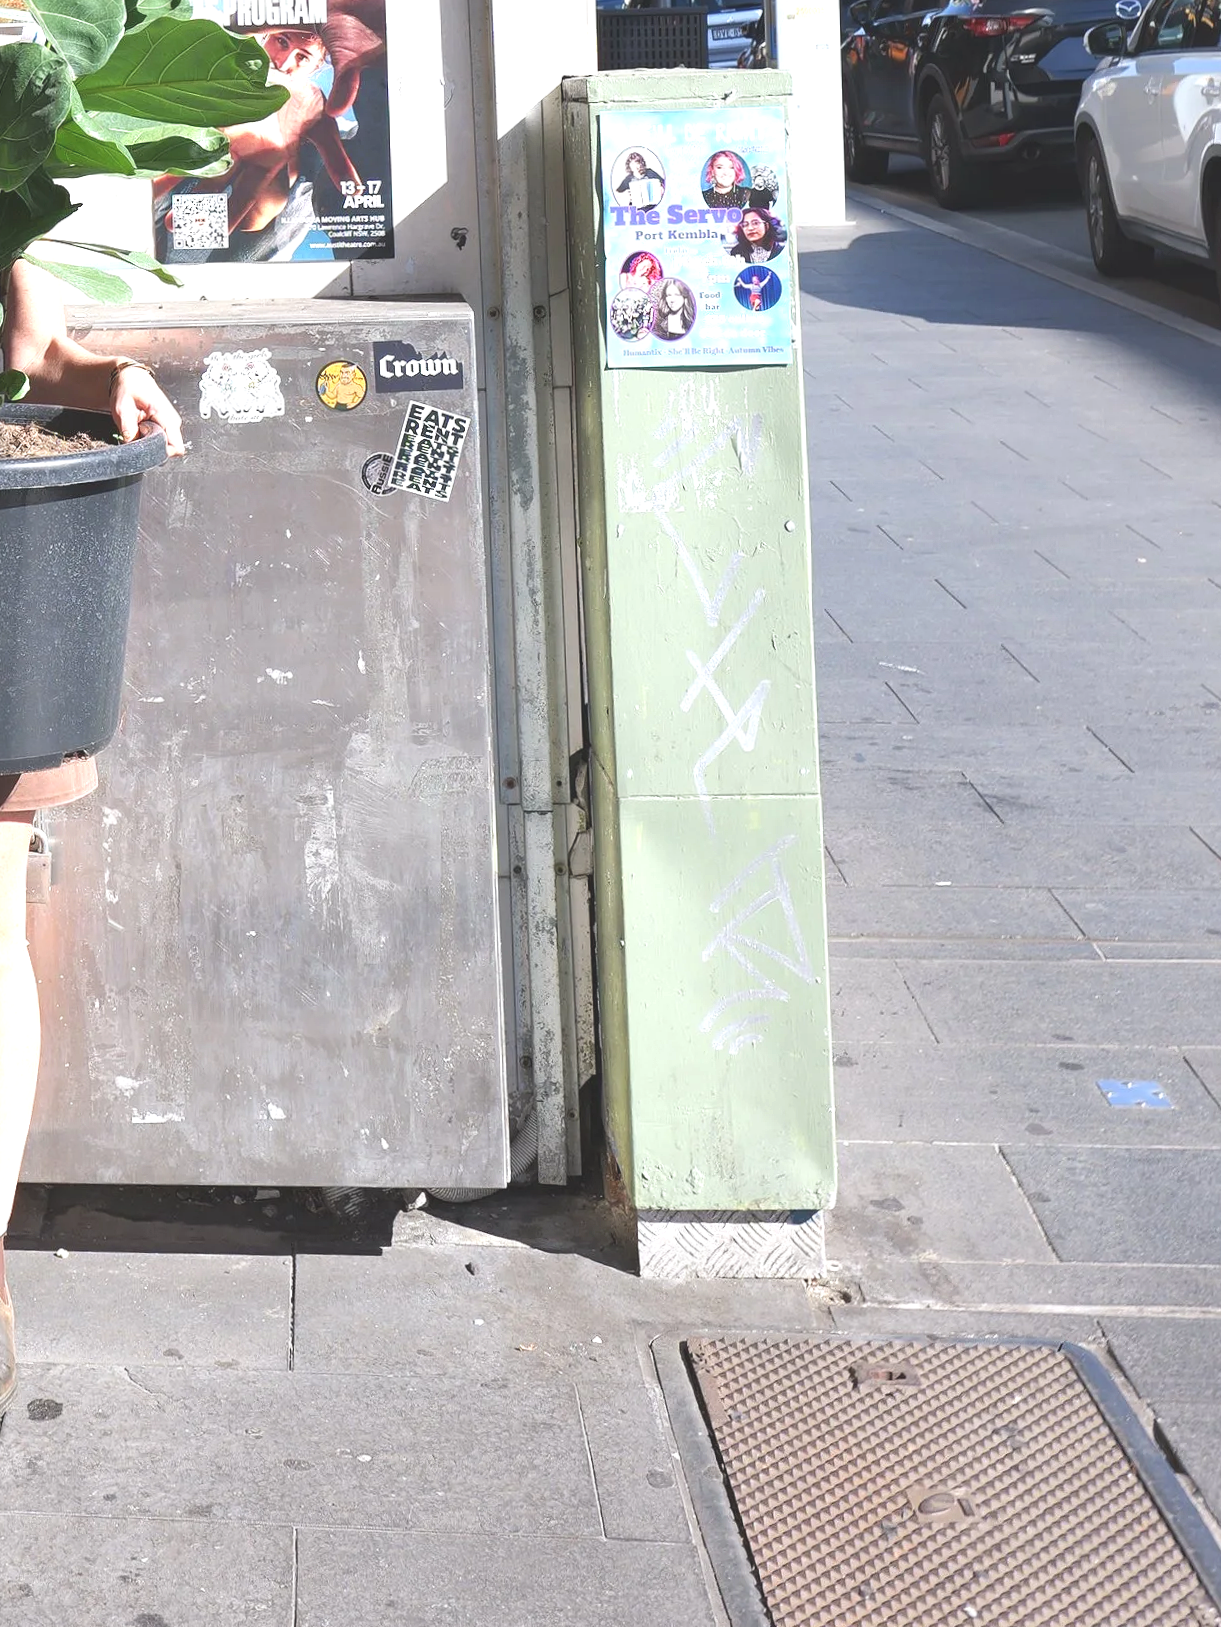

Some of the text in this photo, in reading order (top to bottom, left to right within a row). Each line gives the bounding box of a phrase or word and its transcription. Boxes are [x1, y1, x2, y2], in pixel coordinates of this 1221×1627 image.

[340, 180, 382, 194] 13 17
[343, 195, 384, 208] APRIL
[610, 204, 743, 226] The Servo
[347, 223, 375, 231] Hargrave
[635, 229, 719, 240] Port Kembla
[728, 346, 761, 355] Autumn
[761, 345, 784, 354] Vibes
[379, 354, 459, 378] Crown
[409, 403, 466, 433] EATS
